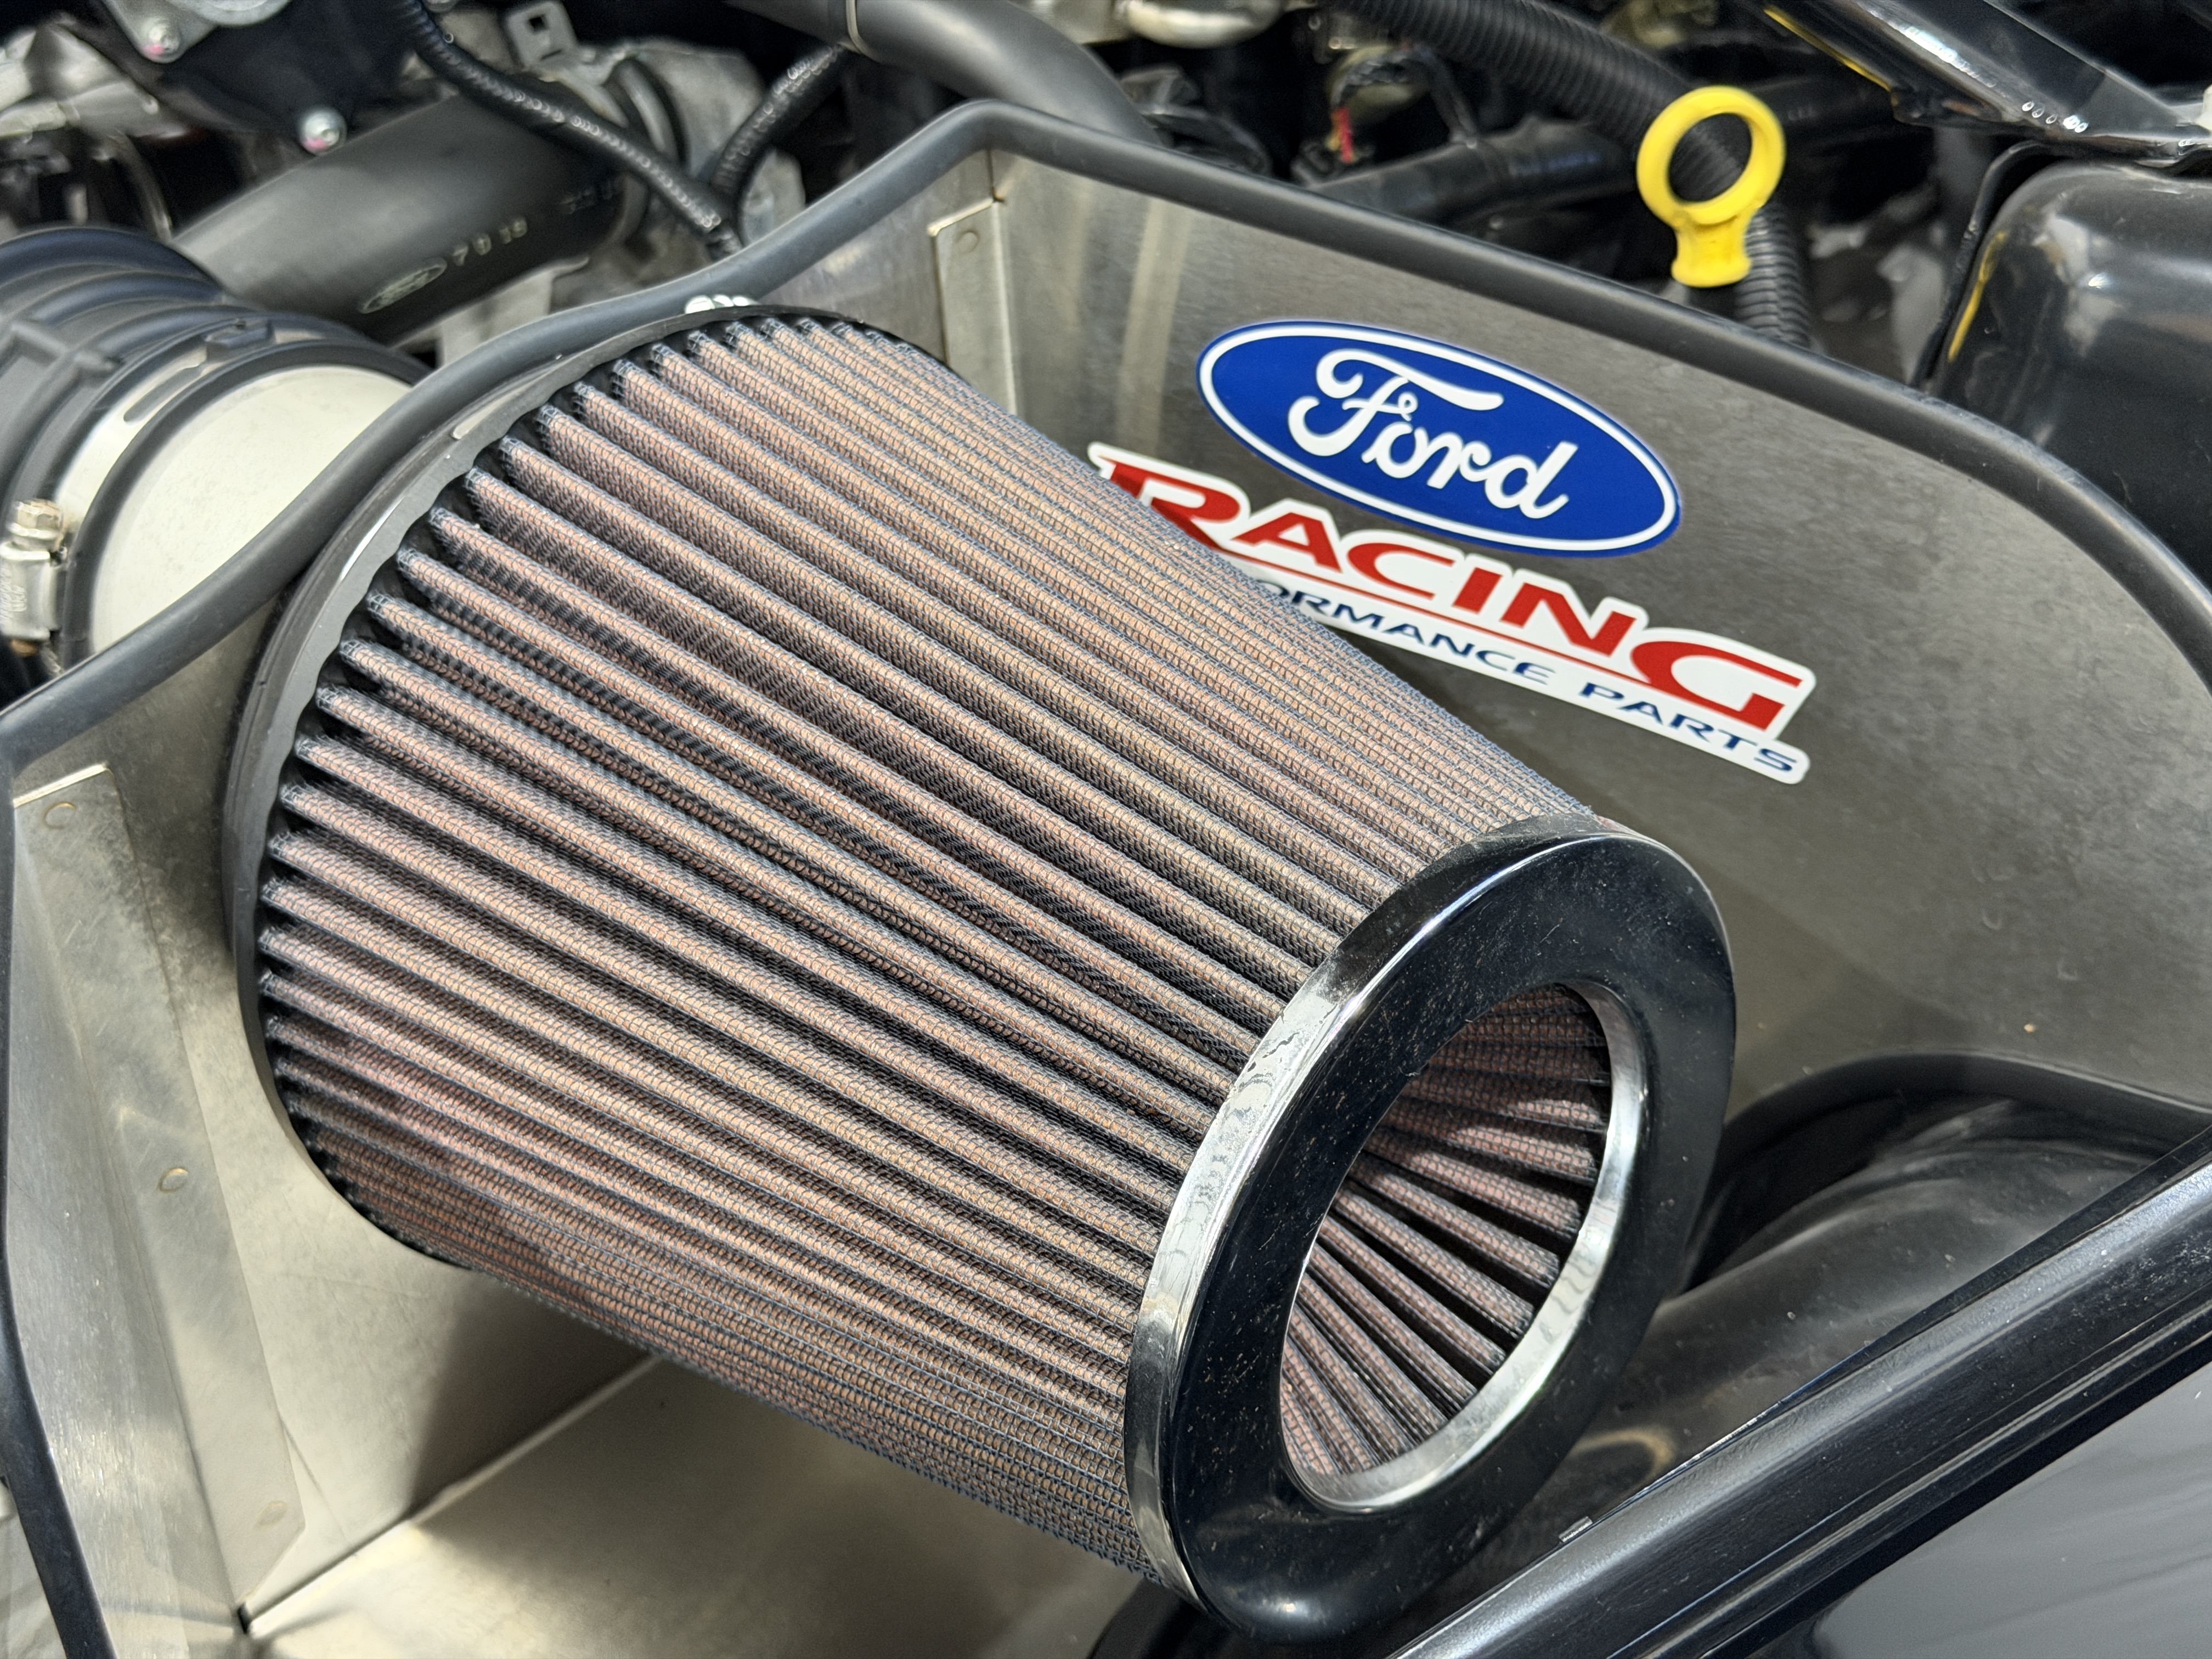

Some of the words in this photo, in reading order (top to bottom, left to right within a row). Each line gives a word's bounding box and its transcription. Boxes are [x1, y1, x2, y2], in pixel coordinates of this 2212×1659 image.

[1288, 348, 1578, 519] Ford
[1097, 456, 1803, 732] RACING
[1579, 682, 1797, 772] PARTS
